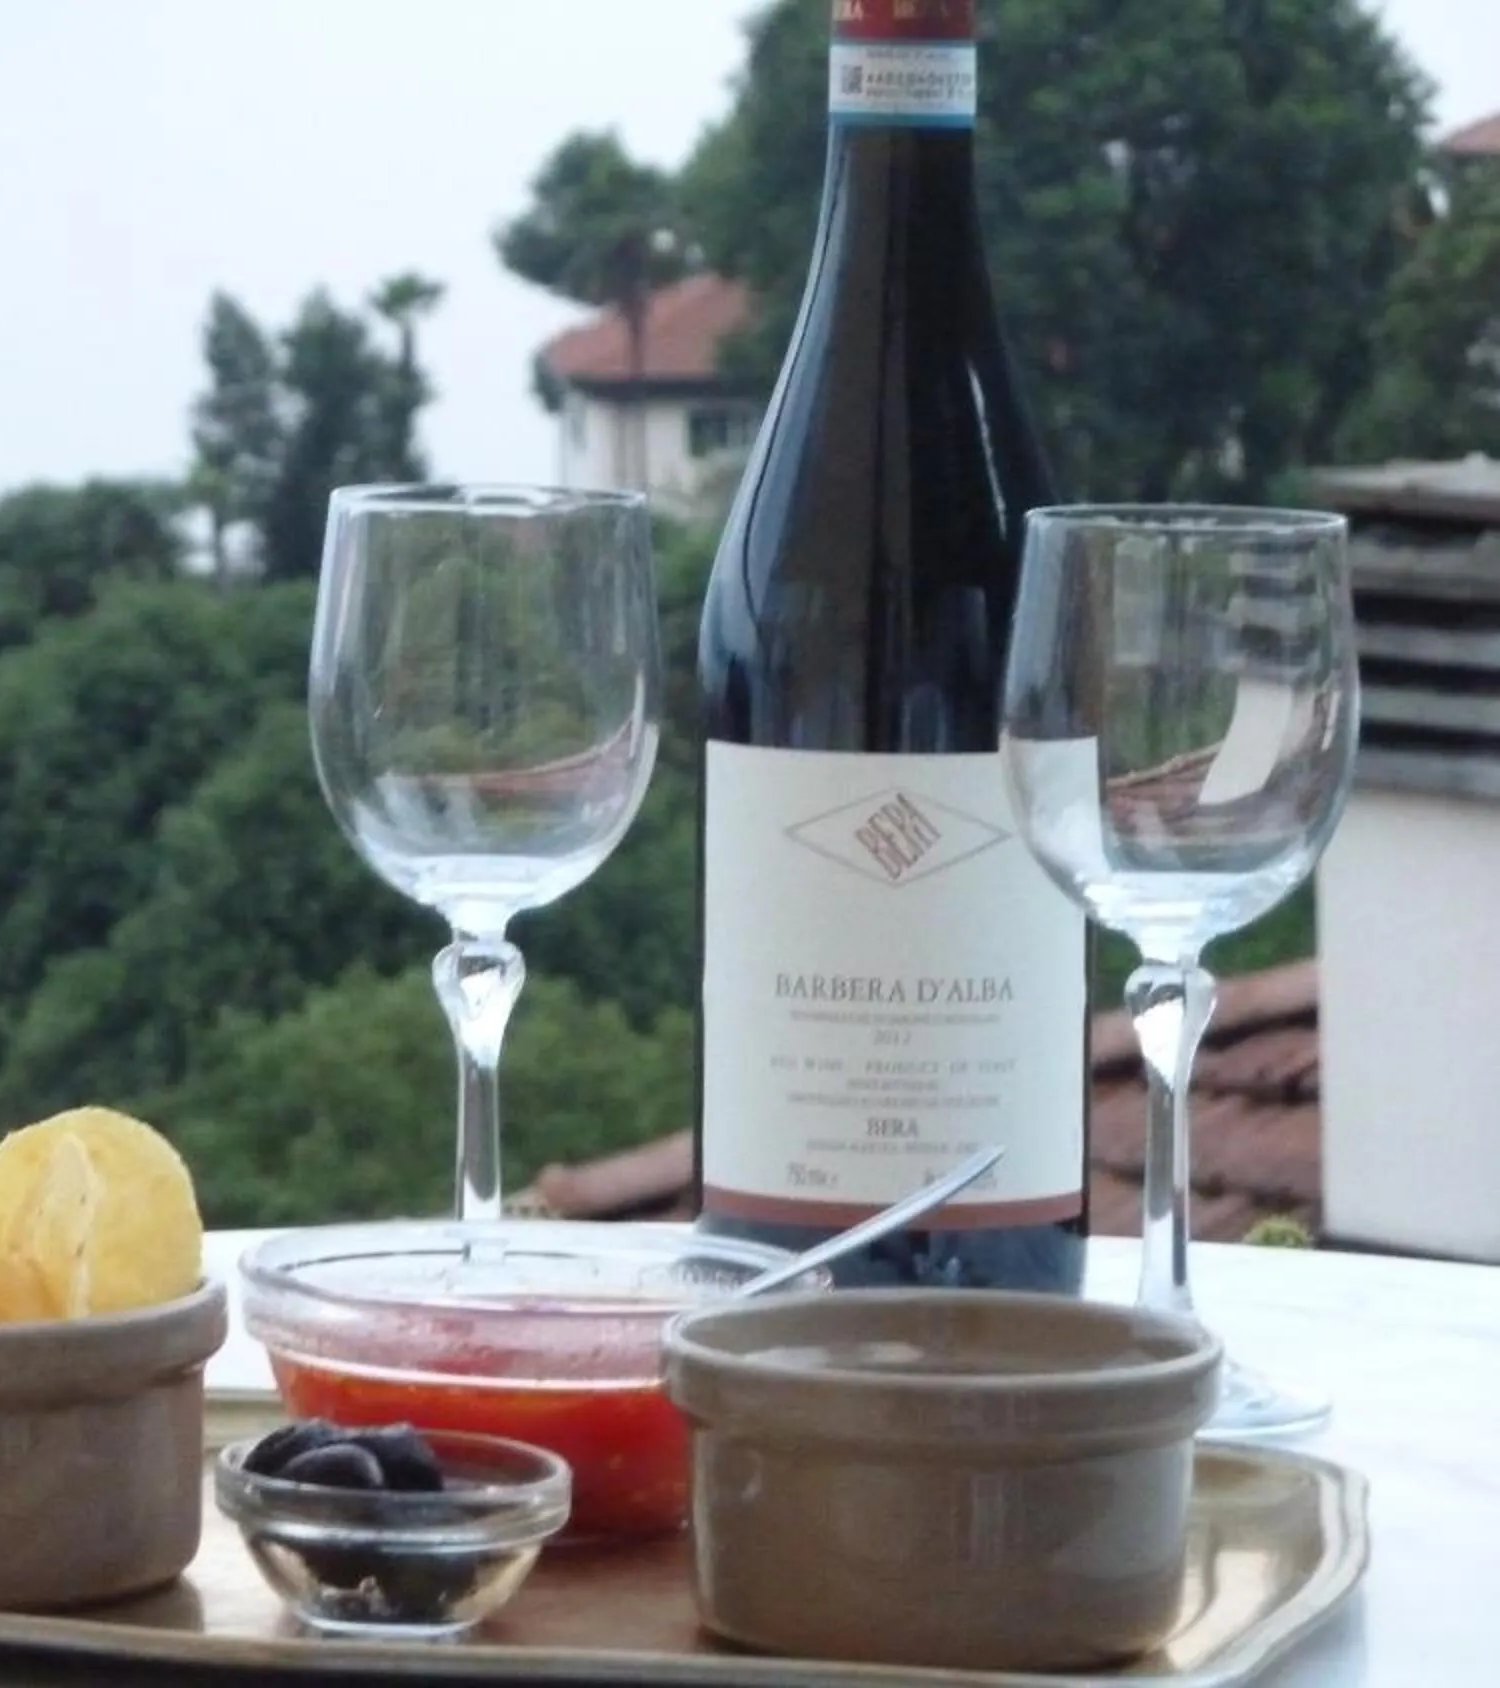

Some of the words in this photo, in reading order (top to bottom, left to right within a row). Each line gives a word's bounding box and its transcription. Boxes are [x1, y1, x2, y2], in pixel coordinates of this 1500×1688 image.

[854, 793, 942, 880] BERA
[774, 973, 906, 1002] BARBERA
[917, 976, 1014, 1002] D'ALBA
[866, 1117, 920, 1138] BERA
